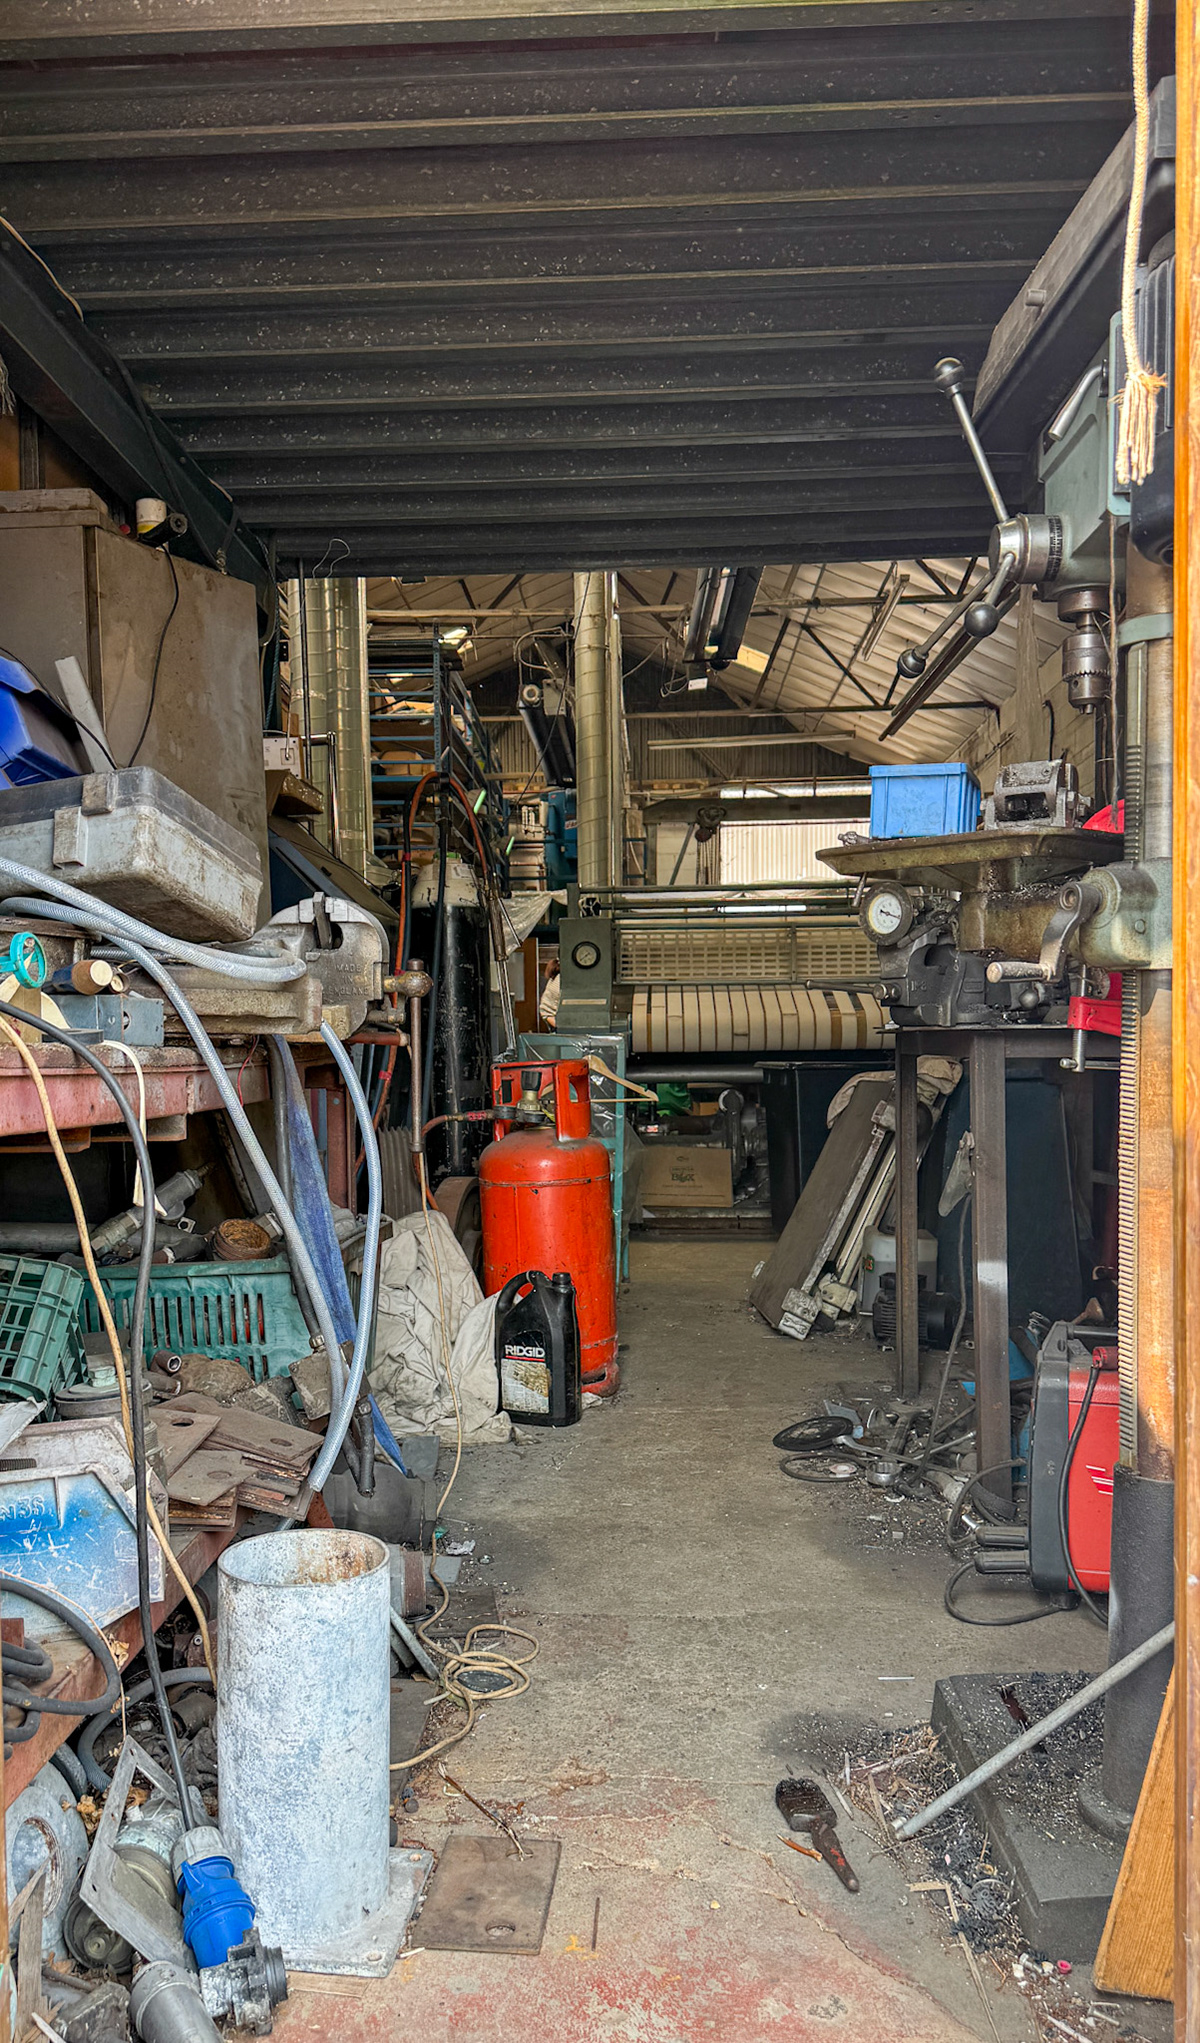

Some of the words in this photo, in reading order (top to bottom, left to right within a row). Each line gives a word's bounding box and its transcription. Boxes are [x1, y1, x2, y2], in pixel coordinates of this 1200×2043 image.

[334, 963, 362, 973] MADE
[342, 975, 354, 985] IN
[328, 985, 370, 997] ENGLAND
[504, 1344, 546, 1358] RIDGID
